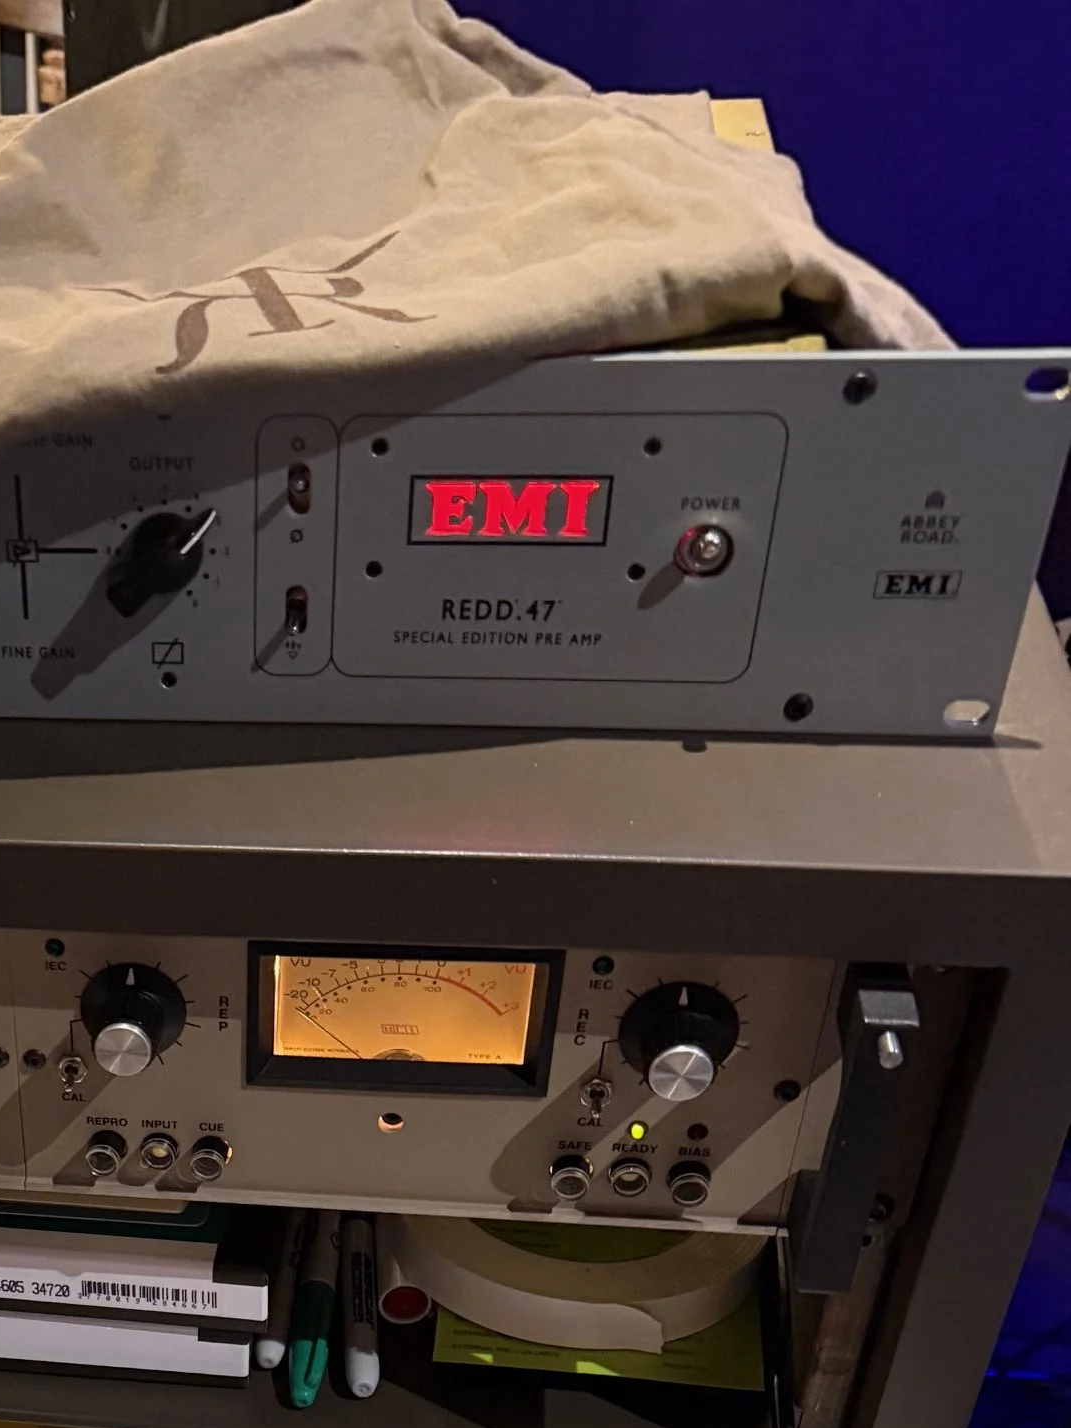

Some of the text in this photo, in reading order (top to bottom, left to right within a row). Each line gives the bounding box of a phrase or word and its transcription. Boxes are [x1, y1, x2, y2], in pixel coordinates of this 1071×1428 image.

[130, 456, 194, 470] OUTPUT
[425, 481, 600, 537] EMI
[680, 497, 741, 511] POWER
[900, 515, 961, 529] ABBEY
[884, 575, 952, 595] EMI
[393, 631, 602, 646] SPECIAL EDITION PRE AMP
[1, 646, 75, 659] FINE GAIN
[46, 961, 66, 971] IEC
[290, 958, 311, 968] VU
[341, 960, 358, 970] -5
[321, 969, 336, 978] -7
[457, 967, 471, 977] +1
[505, 965, 527, 975] VU
[298, 978, 321, 988] -10
[479, 981, 497, 991] +2
[590, 980, 613, 989] IEC
[283, 989, 309, 999] -20
[219, 997, 229, 1031] REP
[574, 1009, 589, 1046] REC
[62, 1092, 85, 1102] CAL
[86, 1117, 128, 1127] REPRO
[141, 1120, 177, 1130] INPUT
[577, 1117, 603, 1127] CAL
[199, 1123, 224, 1132] CUE
[558, 1140, 592, 1150] SAFE
[612, 1143, 658, 1153] READY
[679, 1147, 711, 1157] BIAS
[31, 1282, 70, 1298] 34720
